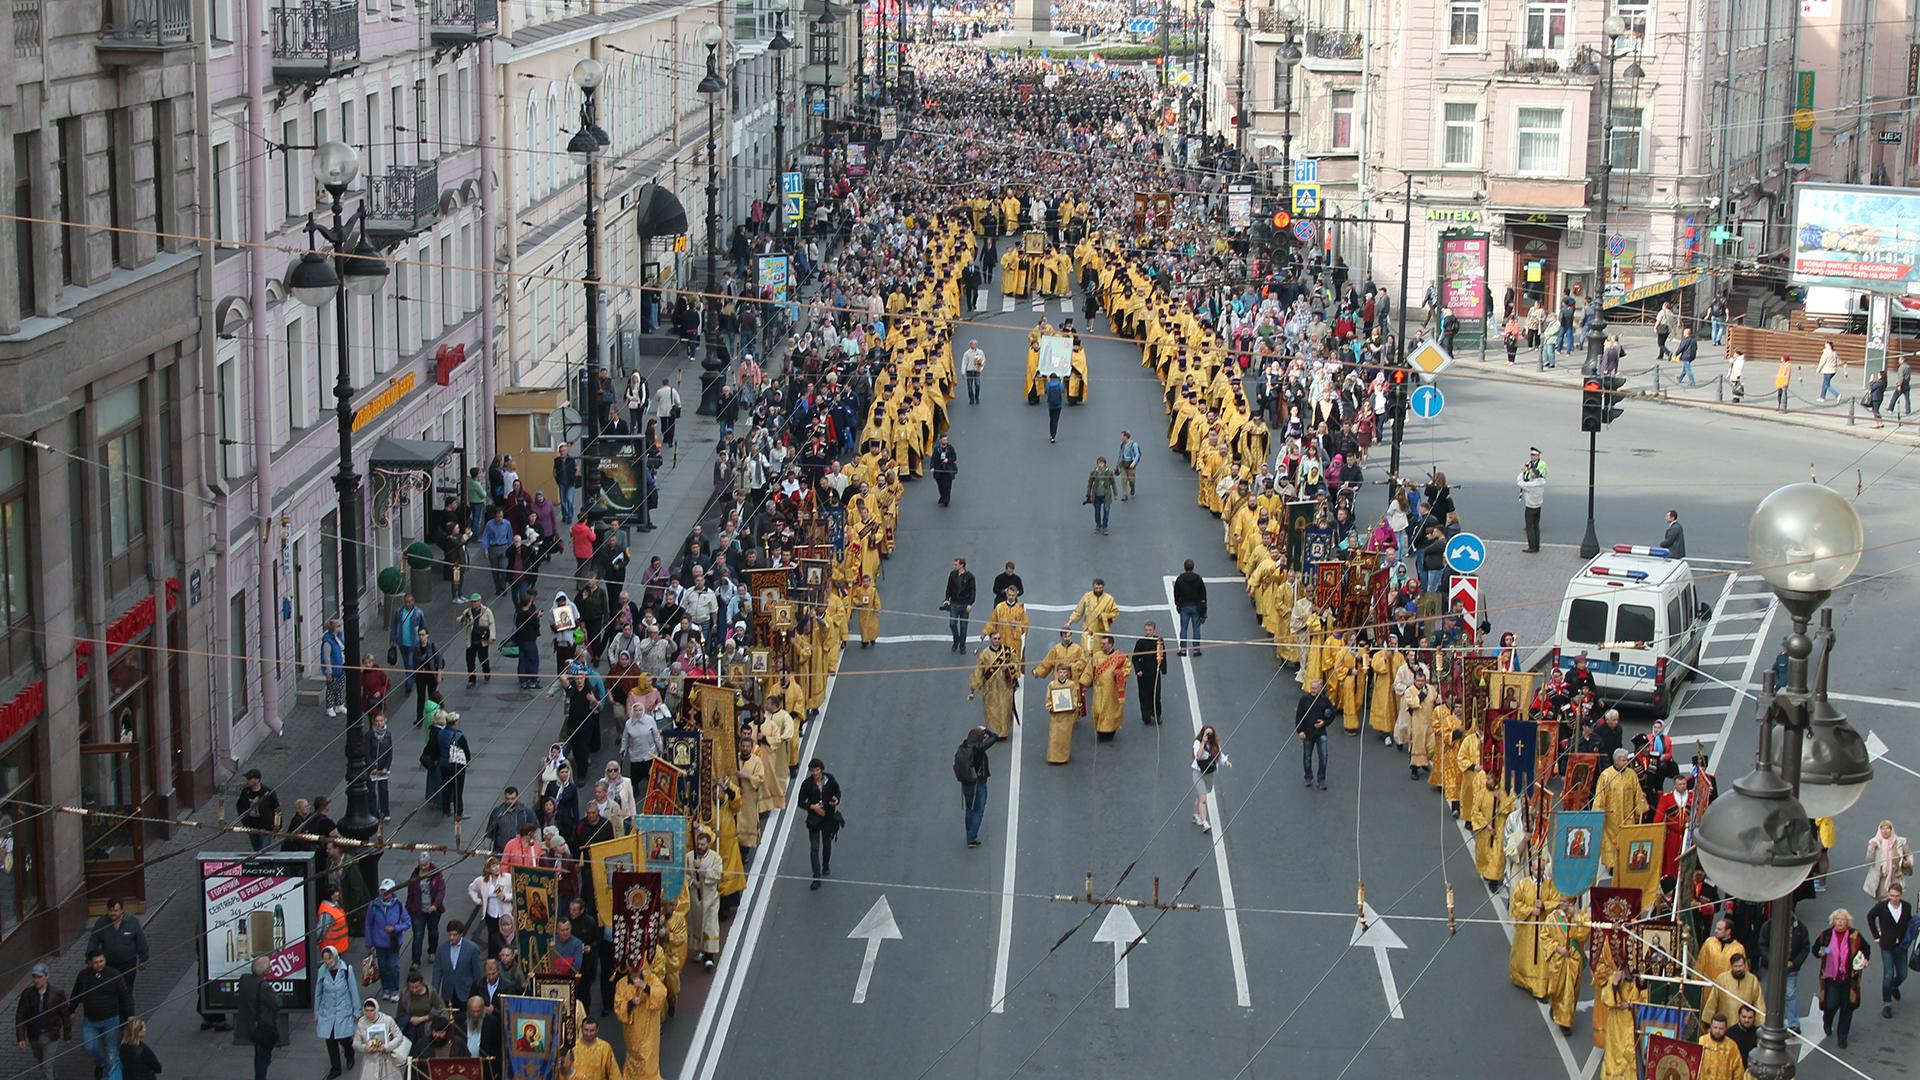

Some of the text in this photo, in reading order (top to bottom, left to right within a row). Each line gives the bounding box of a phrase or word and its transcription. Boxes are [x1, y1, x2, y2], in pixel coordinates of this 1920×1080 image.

[1879, 132, 1901, 141] ЦЕХ
[1426, 208, 1481, 222] АПТЕКА
[1862, 251, 1915, 265] 611-01-01
[1827, 262, 1852, 270] ФИТНЕС
[1859, 263, 1898, 272] БАССЕЙНОМ
[1616, 663, 1647, 677] ДПС
[210, 878, 241, 898] ГОРЯЧИЙ
[246, 884, 260, 896] РИВ
[259, 877, 274, 891] ГОШ
[208, 896, 241, 915] СЕНТЯБРЬ
[270, 982, 293, 992] ОШ
